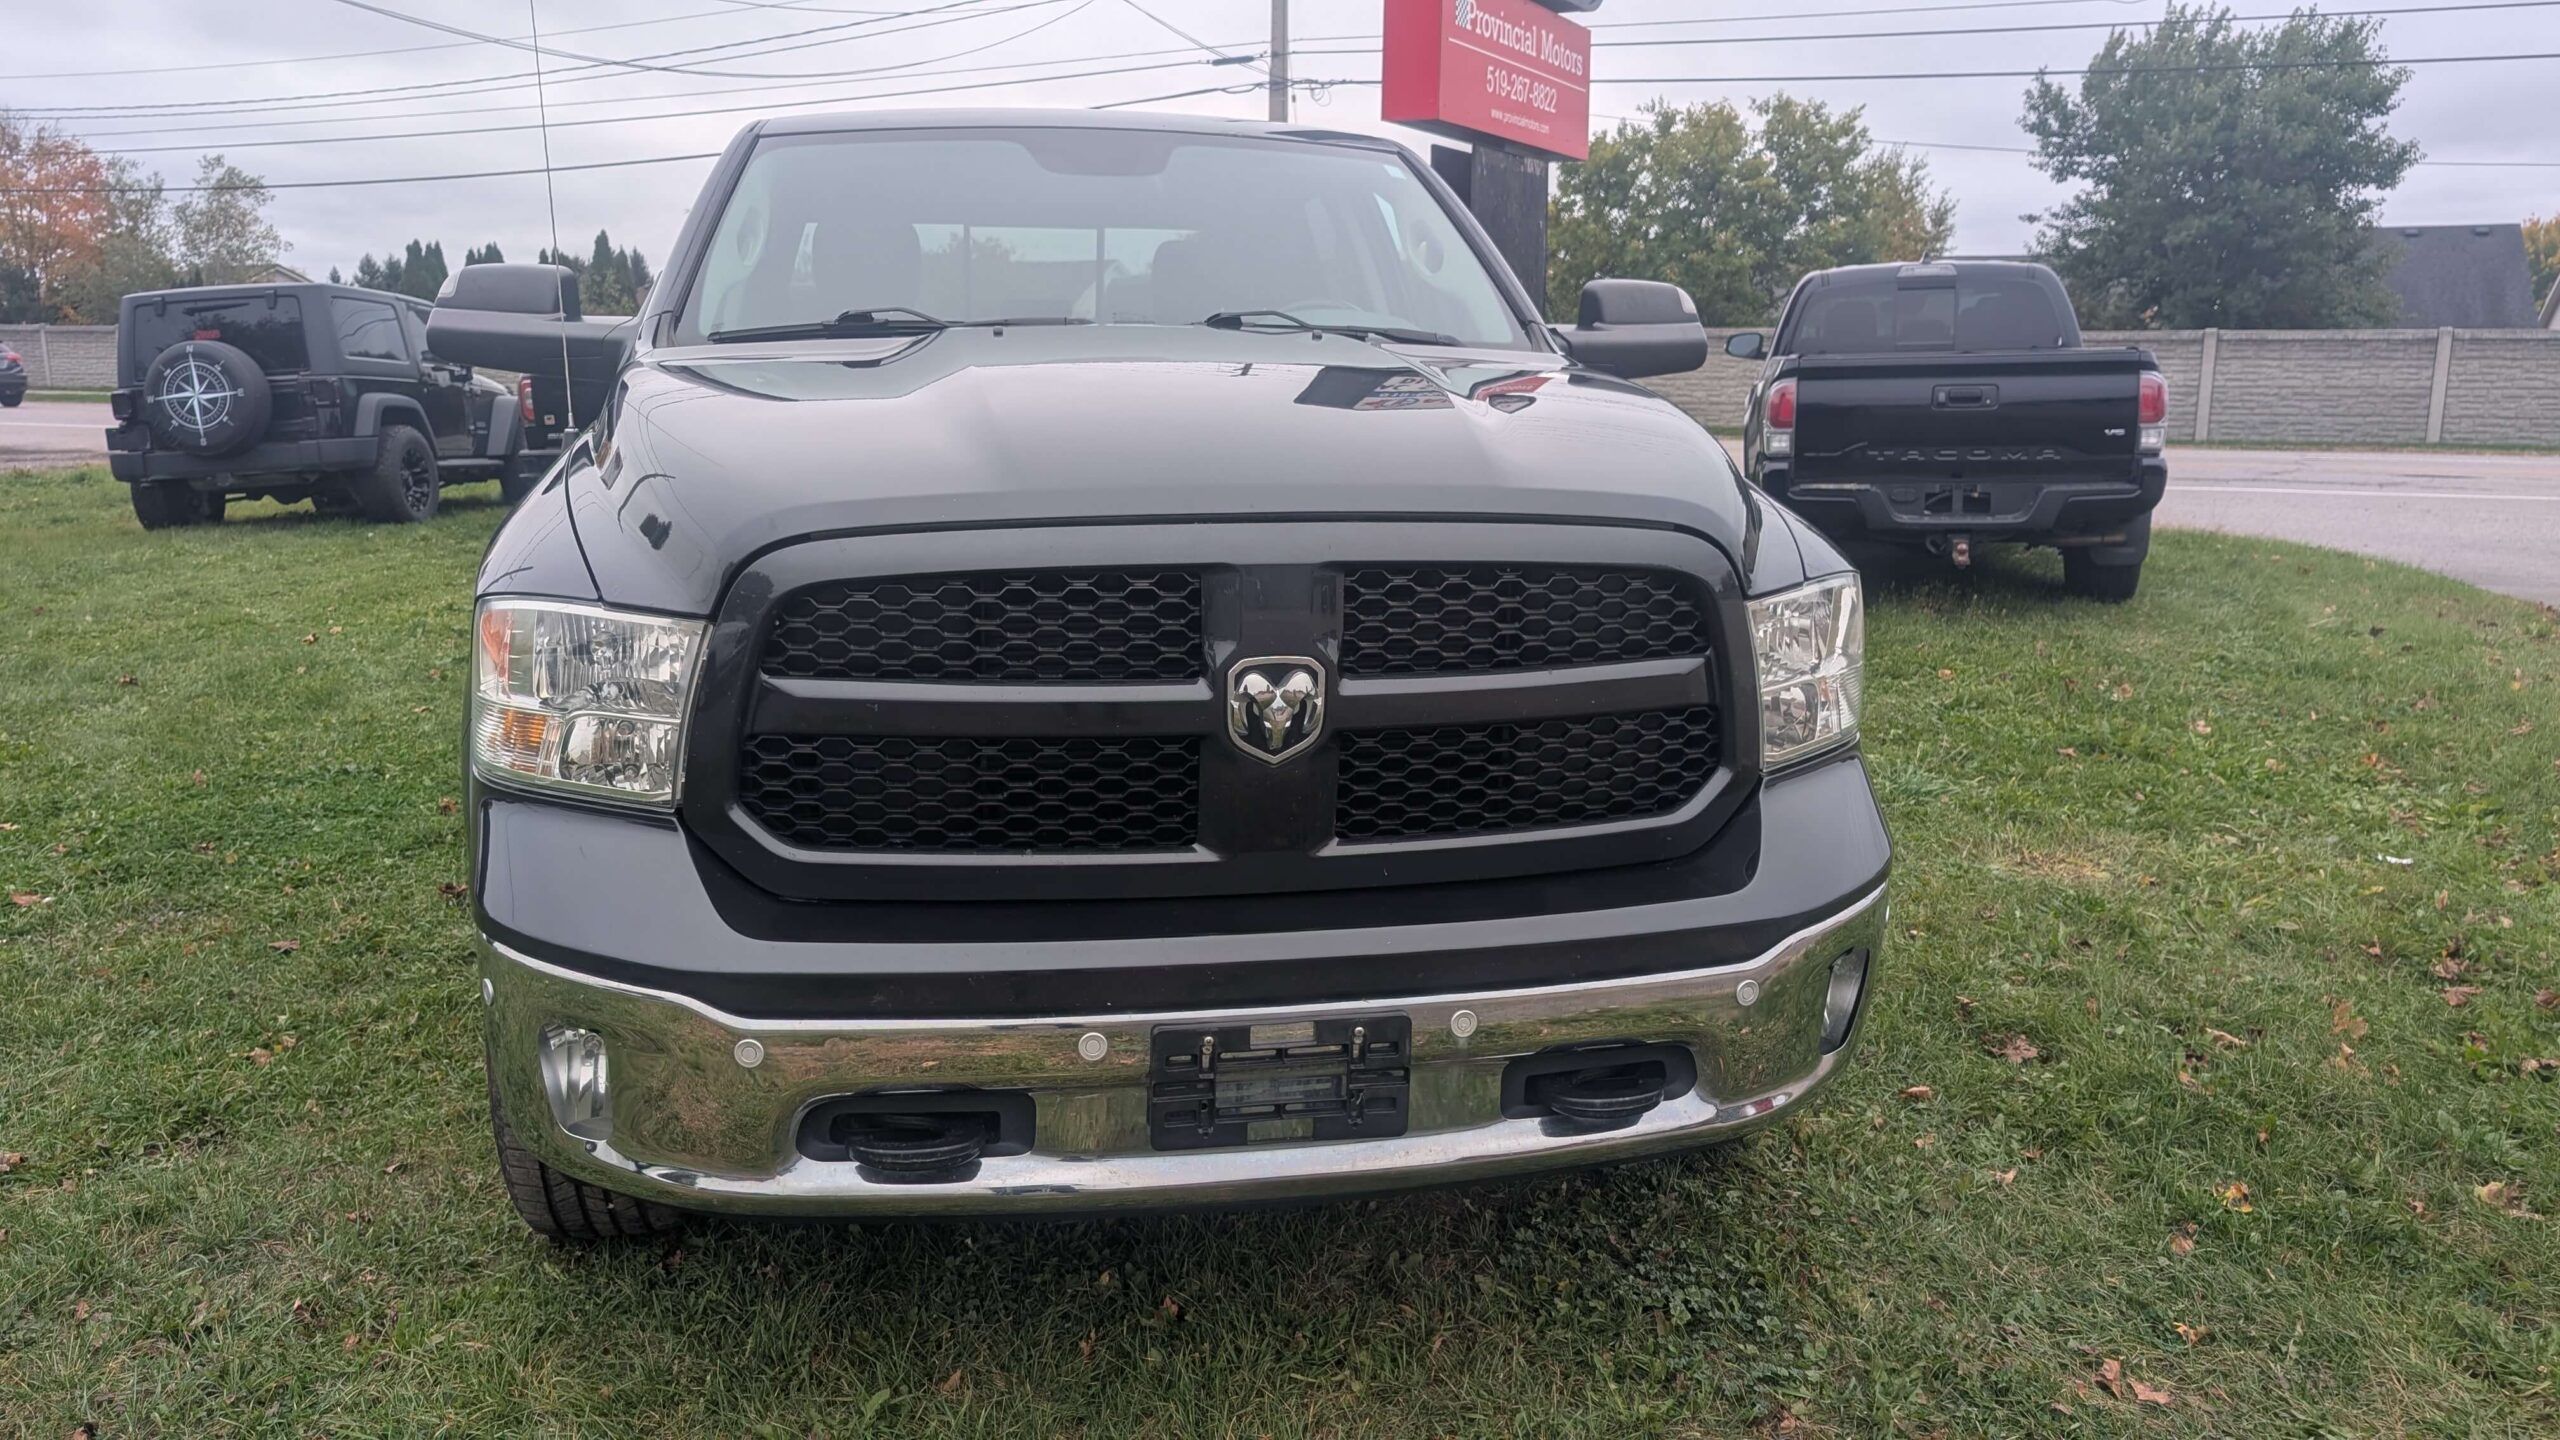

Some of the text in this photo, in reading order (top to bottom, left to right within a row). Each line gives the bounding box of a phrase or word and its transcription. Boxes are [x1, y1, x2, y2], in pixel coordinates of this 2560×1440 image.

[1465, 0, 1583, 76] Provincial Motors
[1486, 65, 1557, 113] 519-267-8822
[185, 344, 194, 353] N
[1867, 449, 2062, 462] TACOMA
